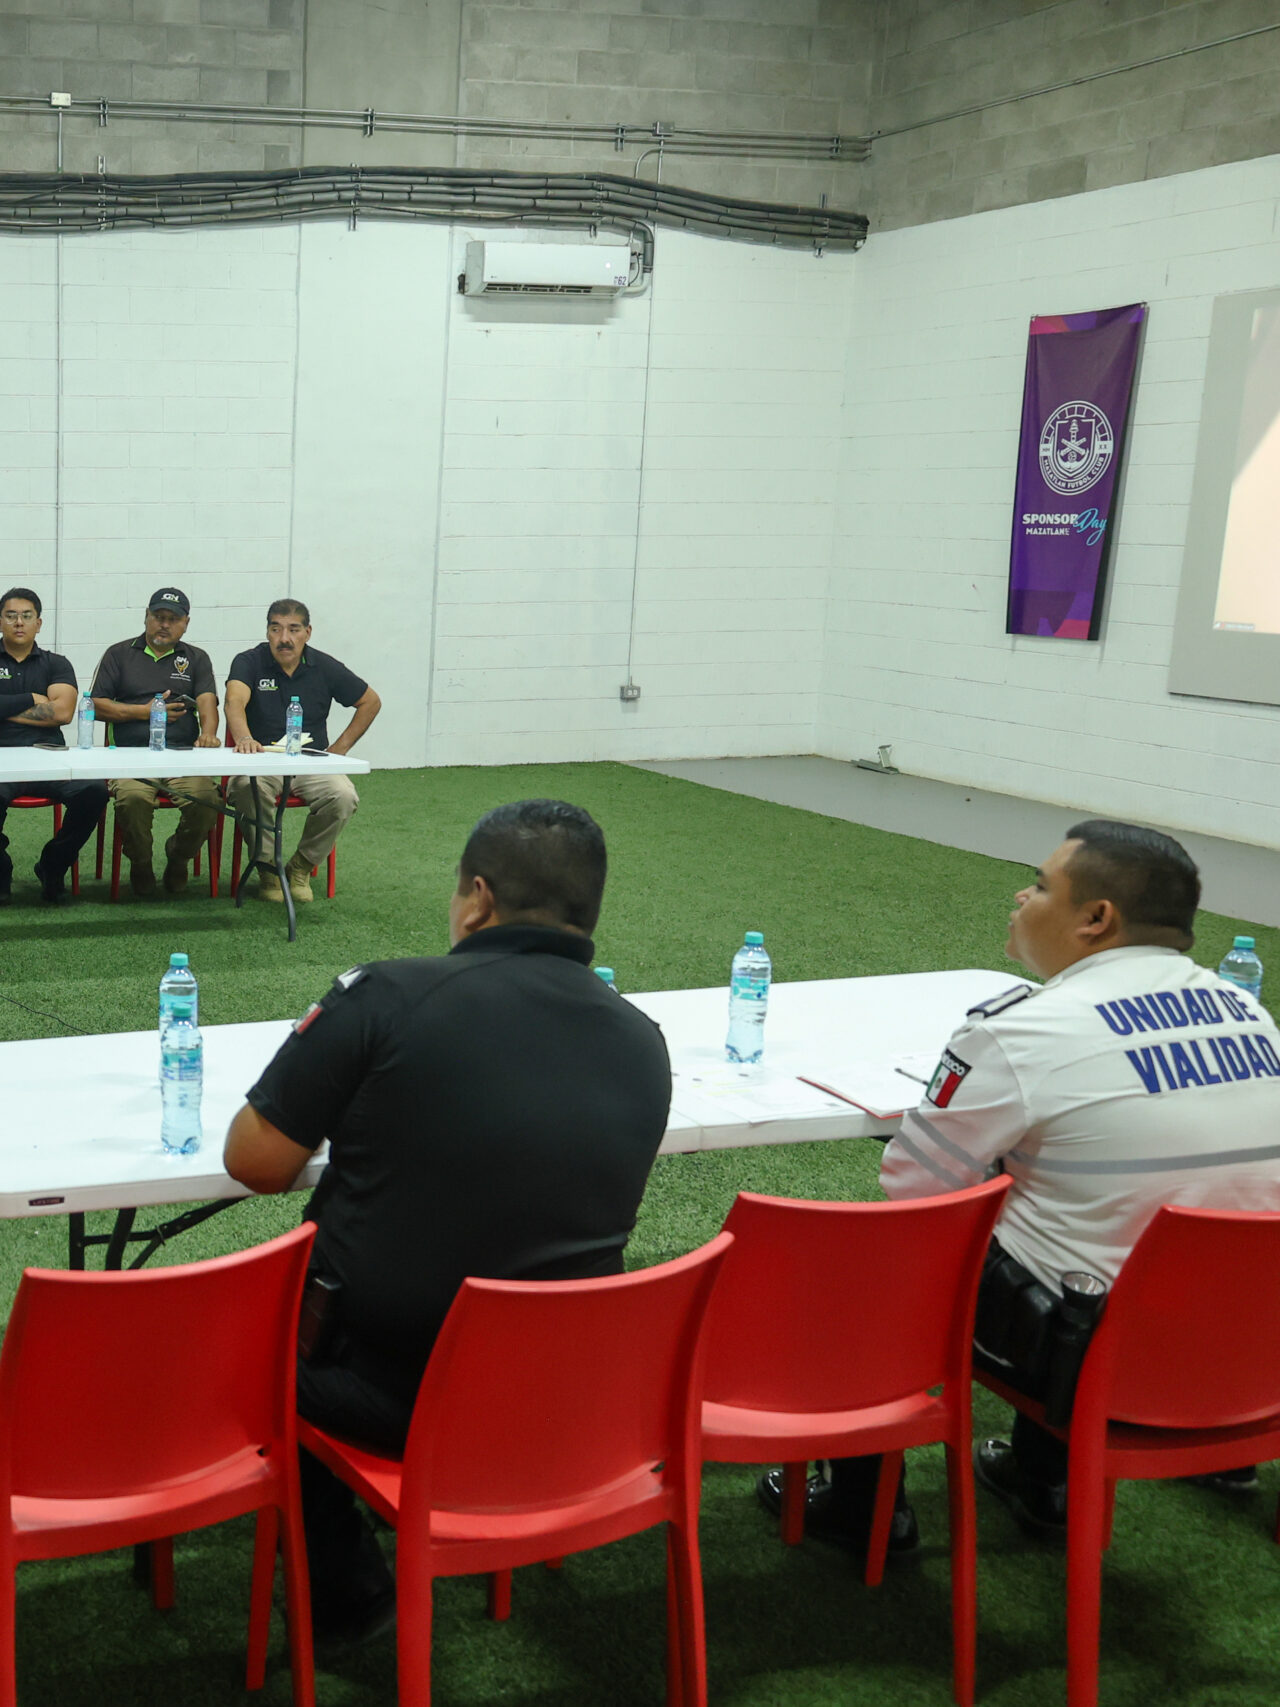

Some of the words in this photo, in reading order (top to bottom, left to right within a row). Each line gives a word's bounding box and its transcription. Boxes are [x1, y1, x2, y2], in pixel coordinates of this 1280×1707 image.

[617, 276, 626, 285] 62
[1067, 475, 1092, 489] FUTBOL
[1091, 456, 1105, 476] CLUB
[1022, 513, 1080, 525] SPONSOR
[1072, 507, 1108, 547] Day
[1094, 988, 1224, 1036] UNIDAD
[1214, 989, 1260, 1022] DE
[1124, 1034, 1280, 1094] VIALIDAD
